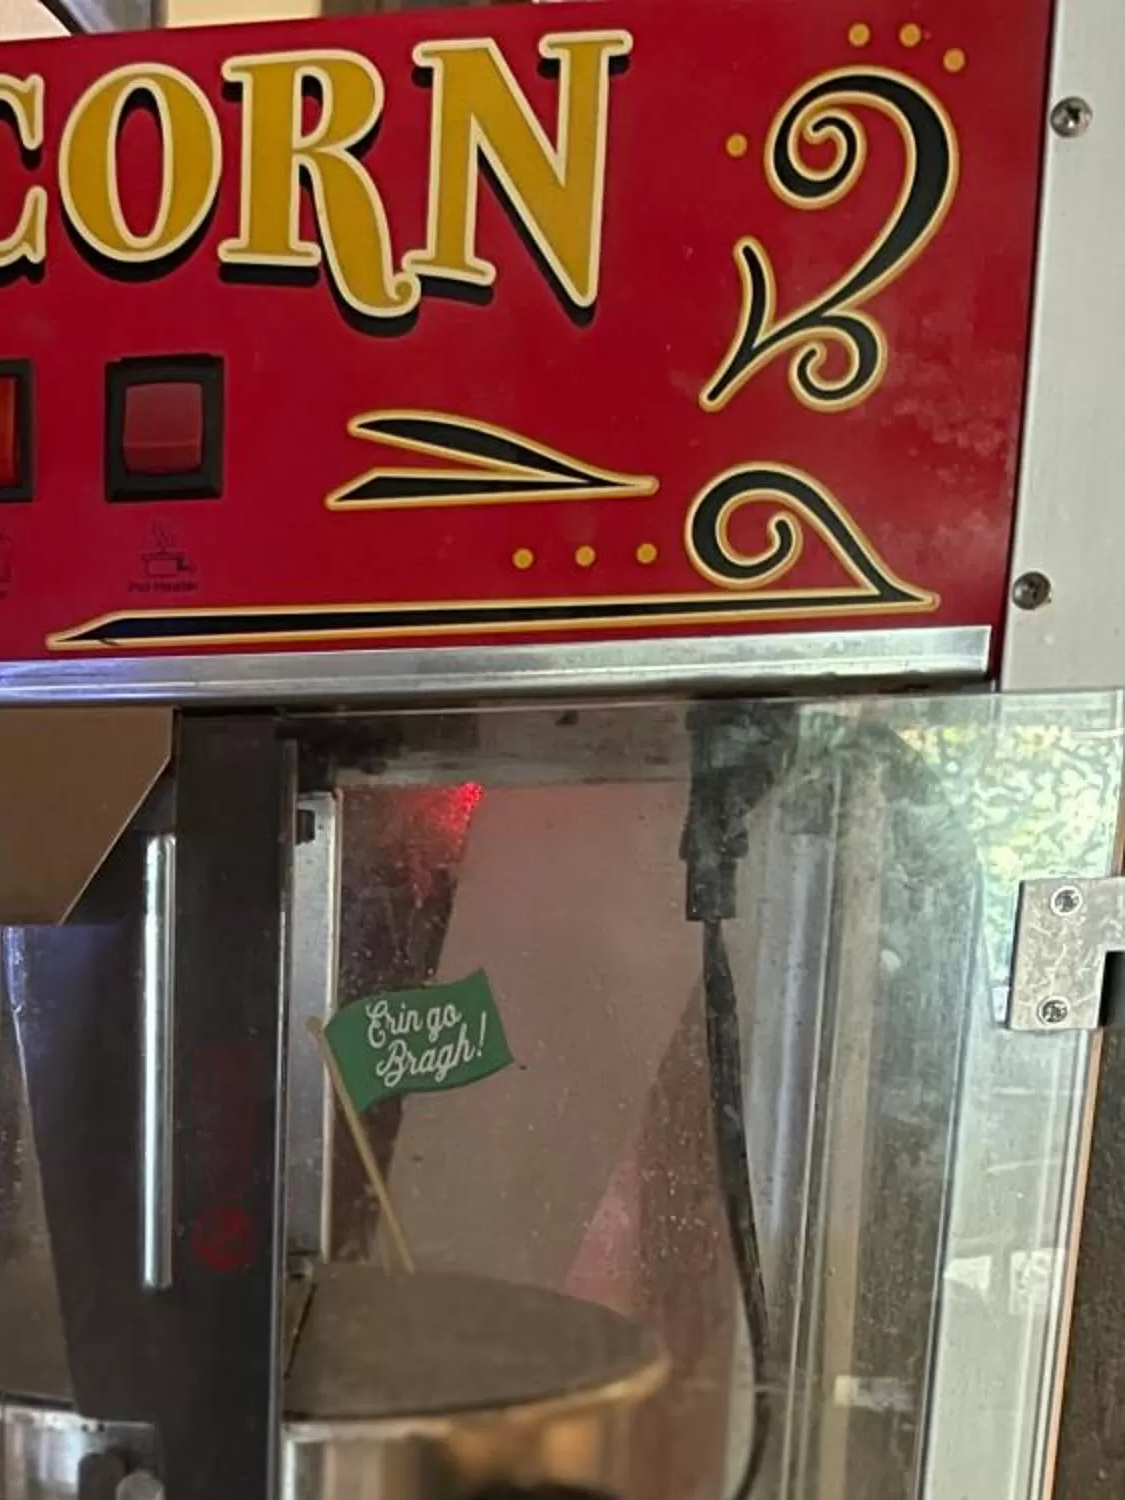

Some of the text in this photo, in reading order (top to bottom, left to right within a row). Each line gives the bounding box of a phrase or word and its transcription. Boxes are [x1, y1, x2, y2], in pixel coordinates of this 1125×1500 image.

[365, 1000, 463, 1048] Erin go
[376, 1011, 487, 1087] Bragh!
